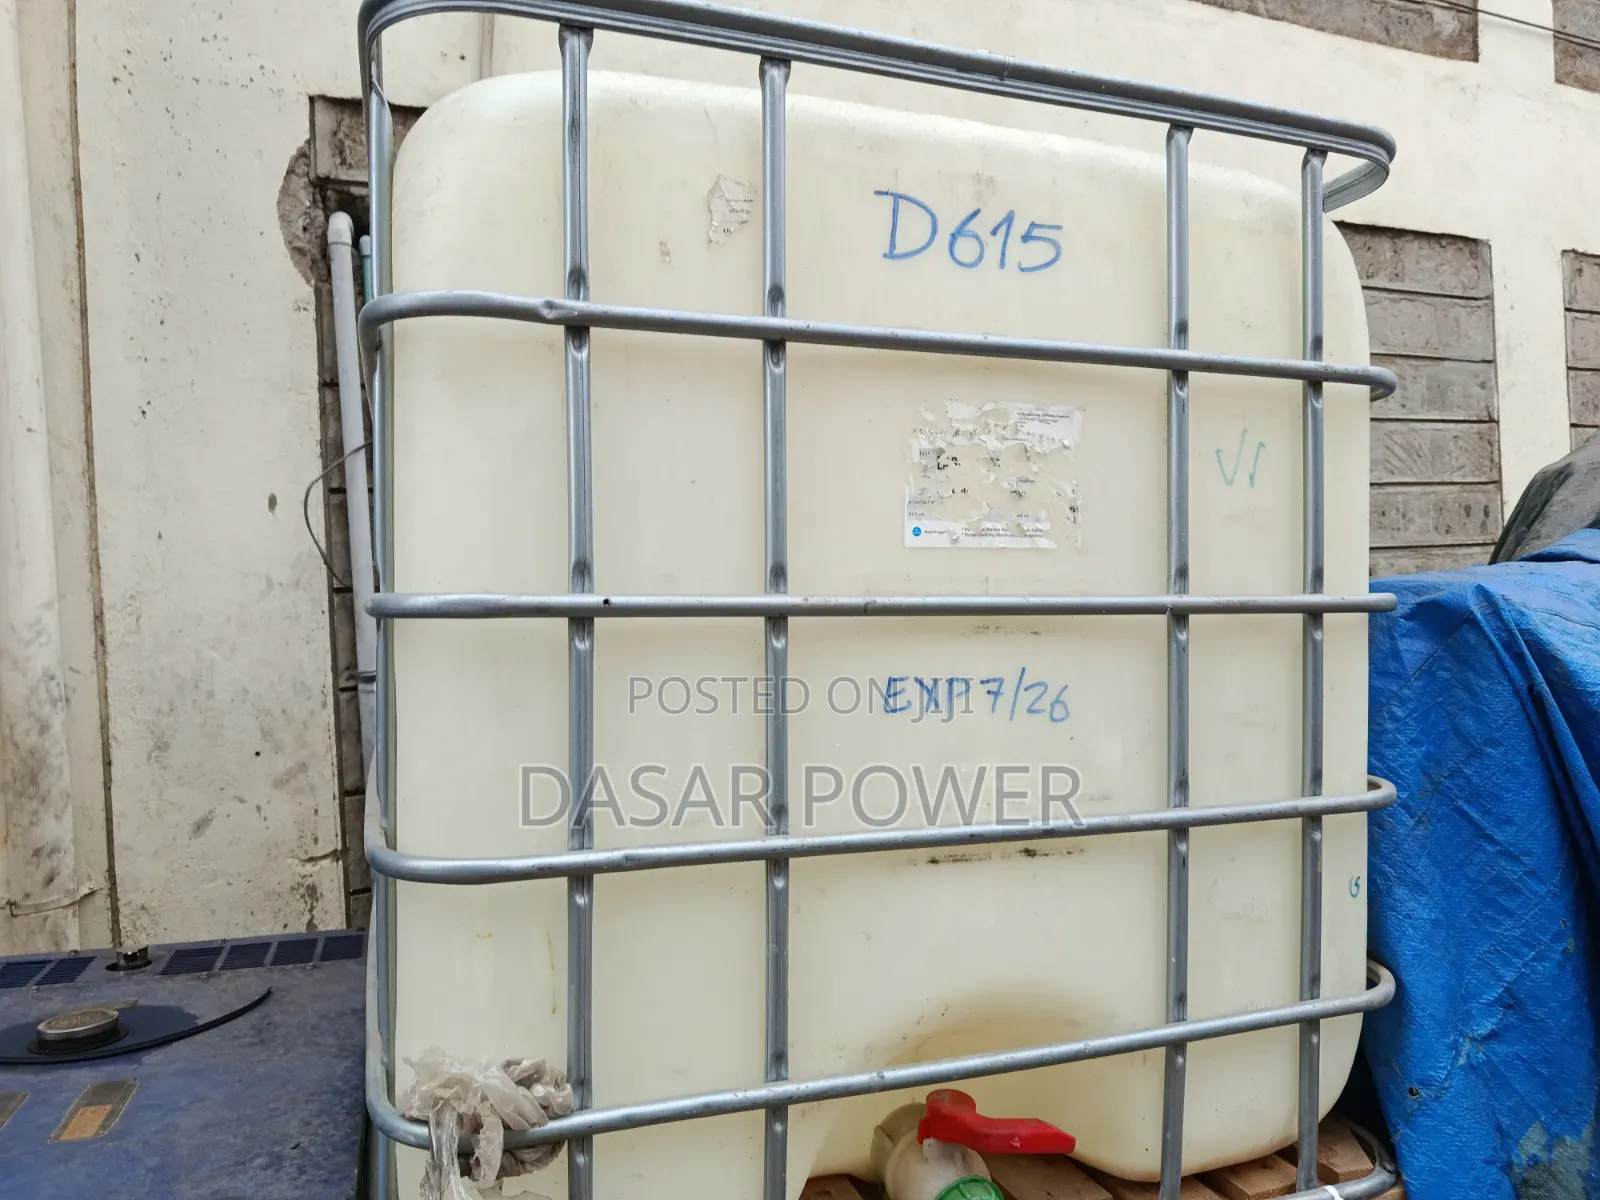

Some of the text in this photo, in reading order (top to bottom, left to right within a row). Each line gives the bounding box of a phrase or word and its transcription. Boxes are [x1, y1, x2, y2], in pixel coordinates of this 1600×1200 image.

[873, 190, 1063, 272] D615
[884, 666, 1071, 723] EXP 7/26
